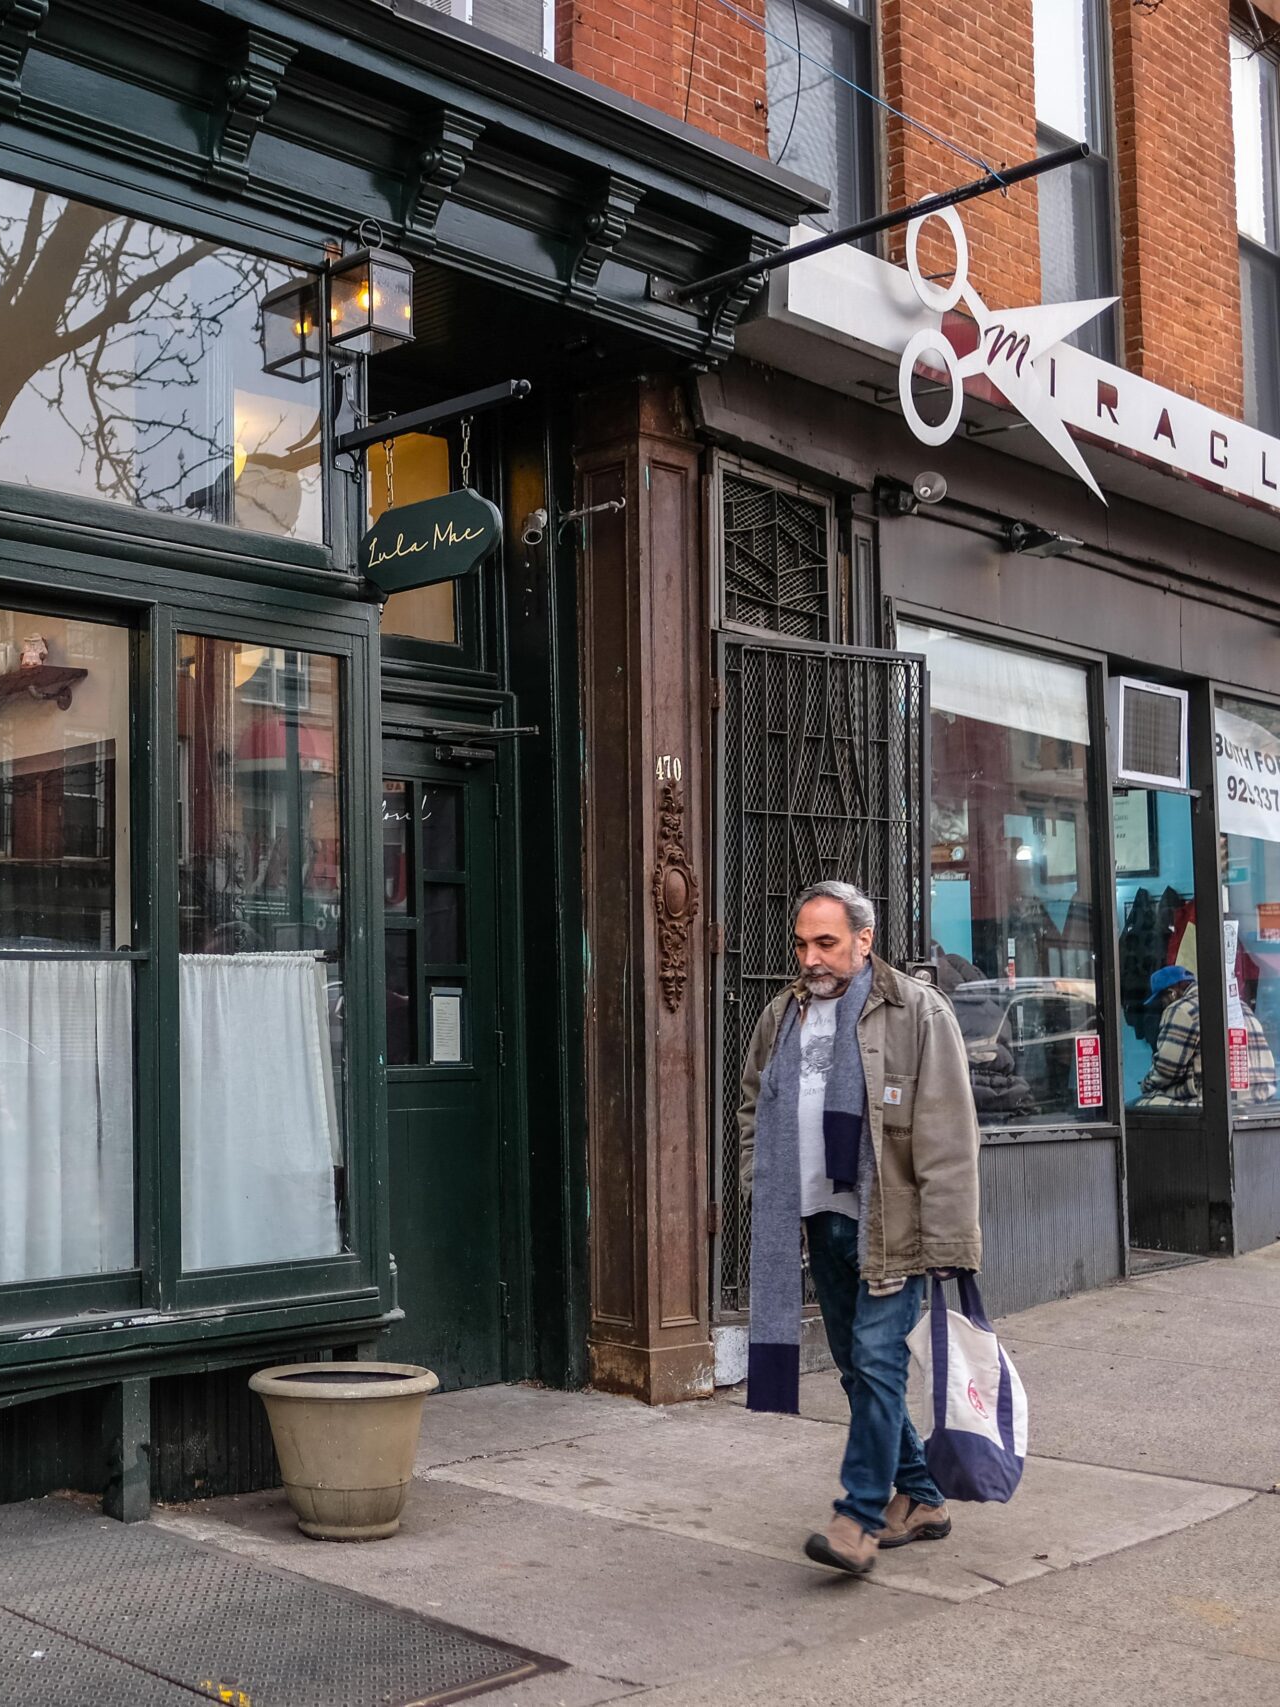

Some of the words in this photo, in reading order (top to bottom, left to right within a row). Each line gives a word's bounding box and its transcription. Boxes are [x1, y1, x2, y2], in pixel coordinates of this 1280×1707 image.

[368, 533, 429, 568] Lula
[433, 521, 485, 550] Mae
[655, 754, 682, 782] 470
